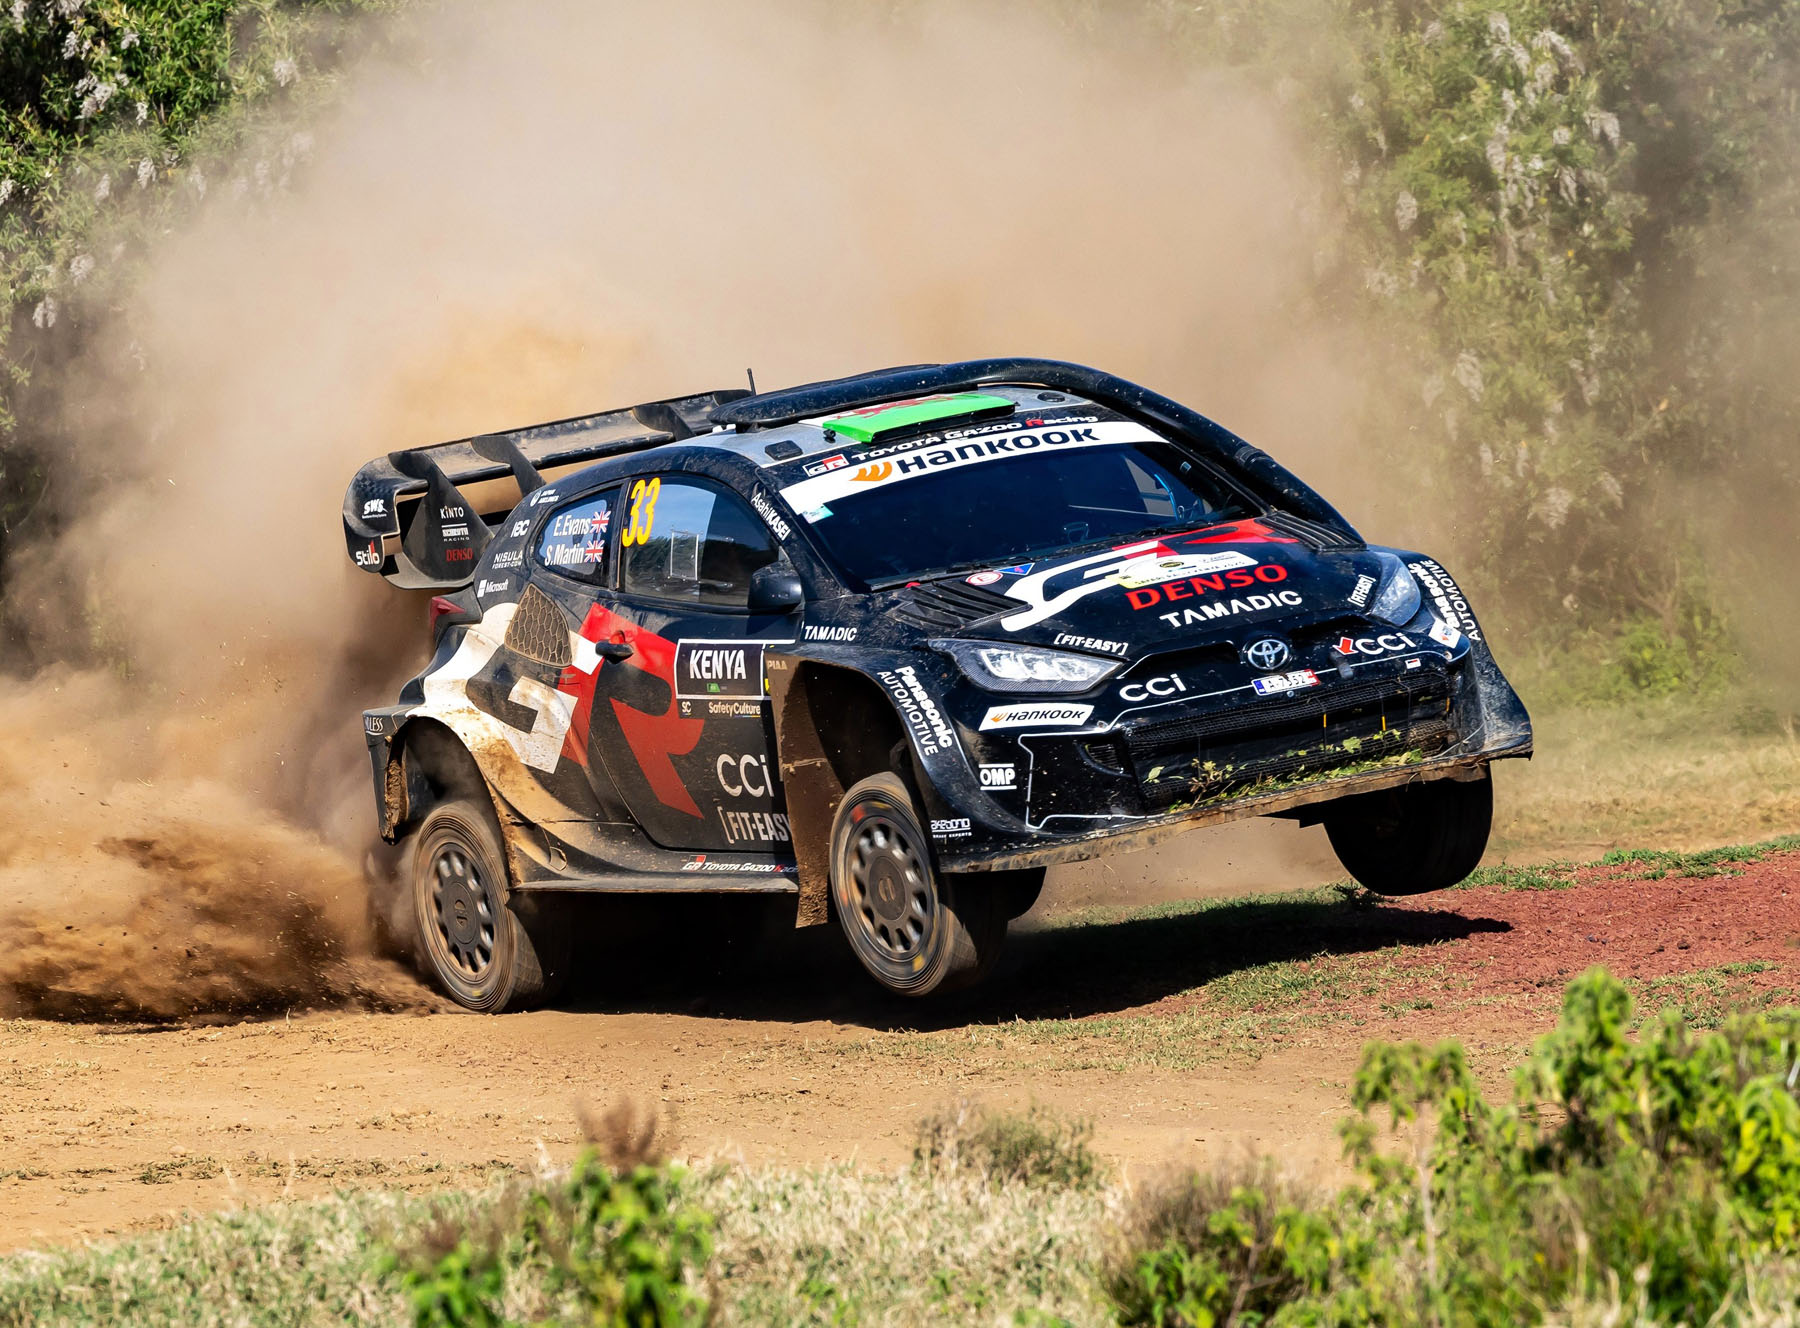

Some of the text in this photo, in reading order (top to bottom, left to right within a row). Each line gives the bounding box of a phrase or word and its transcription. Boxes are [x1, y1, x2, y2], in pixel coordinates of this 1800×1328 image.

[852, 434, 941, 461] TOYOTA
[944, 422, 1023, 441] GAZOO
[622, 477, 660, 547] 33
[445, 547, 474, 562] DENSO
[494, 550, 523, 563] NISULA
[1125, 564, 1288, 611] DENSO
[1159, 590, 1303, 628] TAMADIC
[804, 625, 858, 642] TAMADIC
[689, 649, 747, 680] KENYA
[877, 671, 939, 756] AUTOMOTIVE
[895, 665, 953, 748] Panasonic
[980, 767, 1016, 786] OMP
[702, 861, 740, 872] TOYOTA
